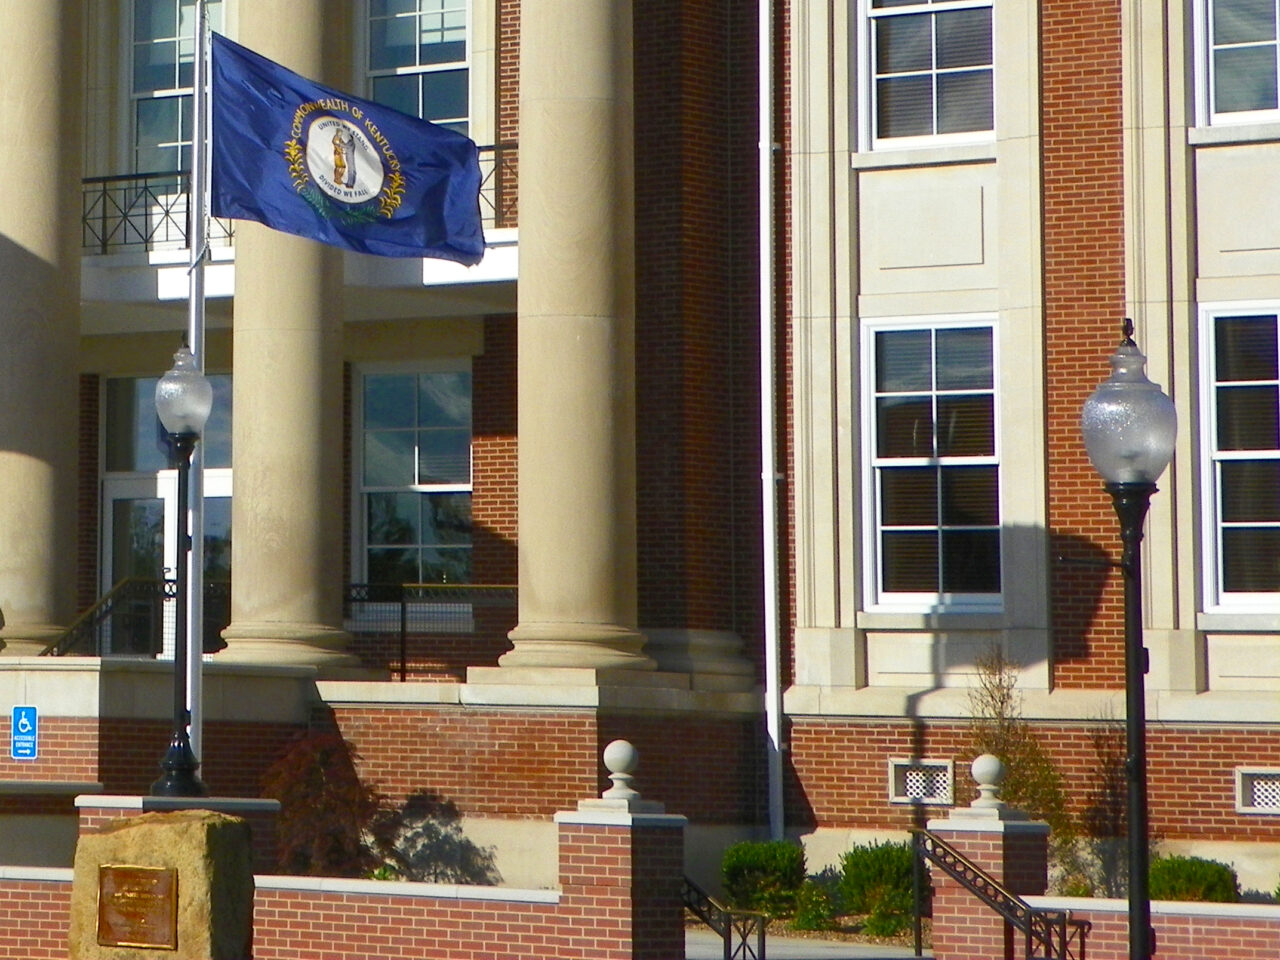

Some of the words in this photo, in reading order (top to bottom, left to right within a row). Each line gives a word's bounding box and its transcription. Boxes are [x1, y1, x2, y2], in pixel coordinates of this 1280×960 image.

[291, 98, 349, 139] COMMONWEALTH
[351, 106, 364, 120] OF
[364, 117, 402, 173] KENTUCKY
[317, 120, 341, 131] UNITED
[318, 174, 342, 196] DIVIDED
[343, 189, 353, 198] WE
[354, 189, 369, 198] FALL
